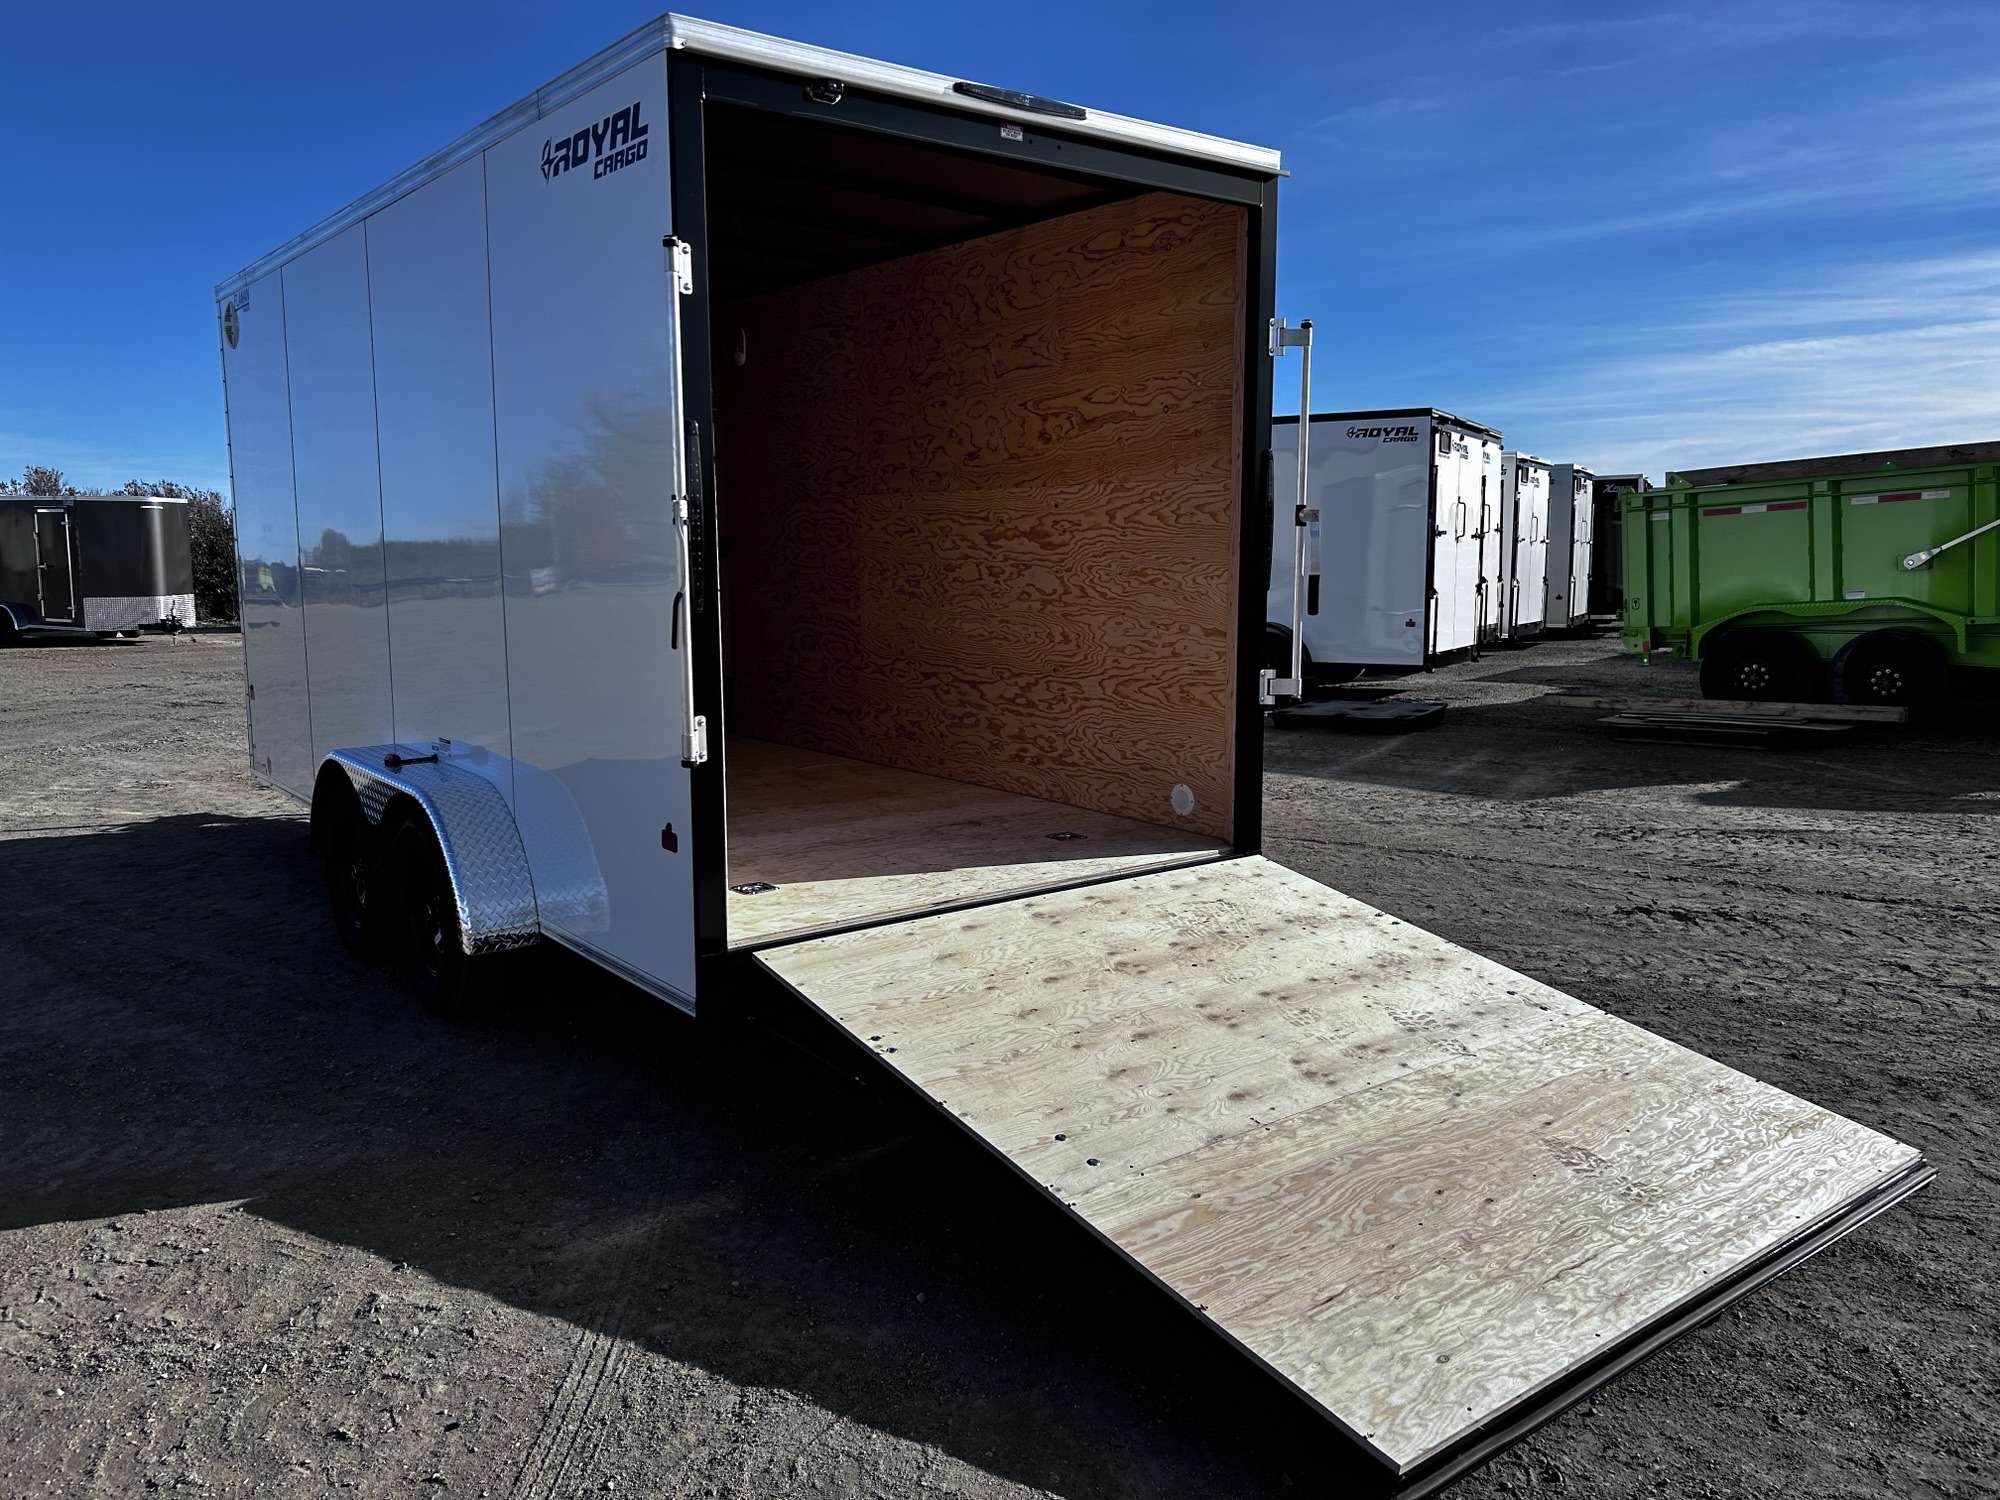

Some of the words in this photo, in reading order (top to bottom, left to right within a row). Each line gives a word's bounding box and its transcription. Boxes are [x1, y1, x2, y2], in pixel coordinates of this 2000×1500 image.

[553, 101, 649, 177] ROYAL
[593, 138, 649, 180] CARGO
[1354, 426, 1419, 438] ROYAL
